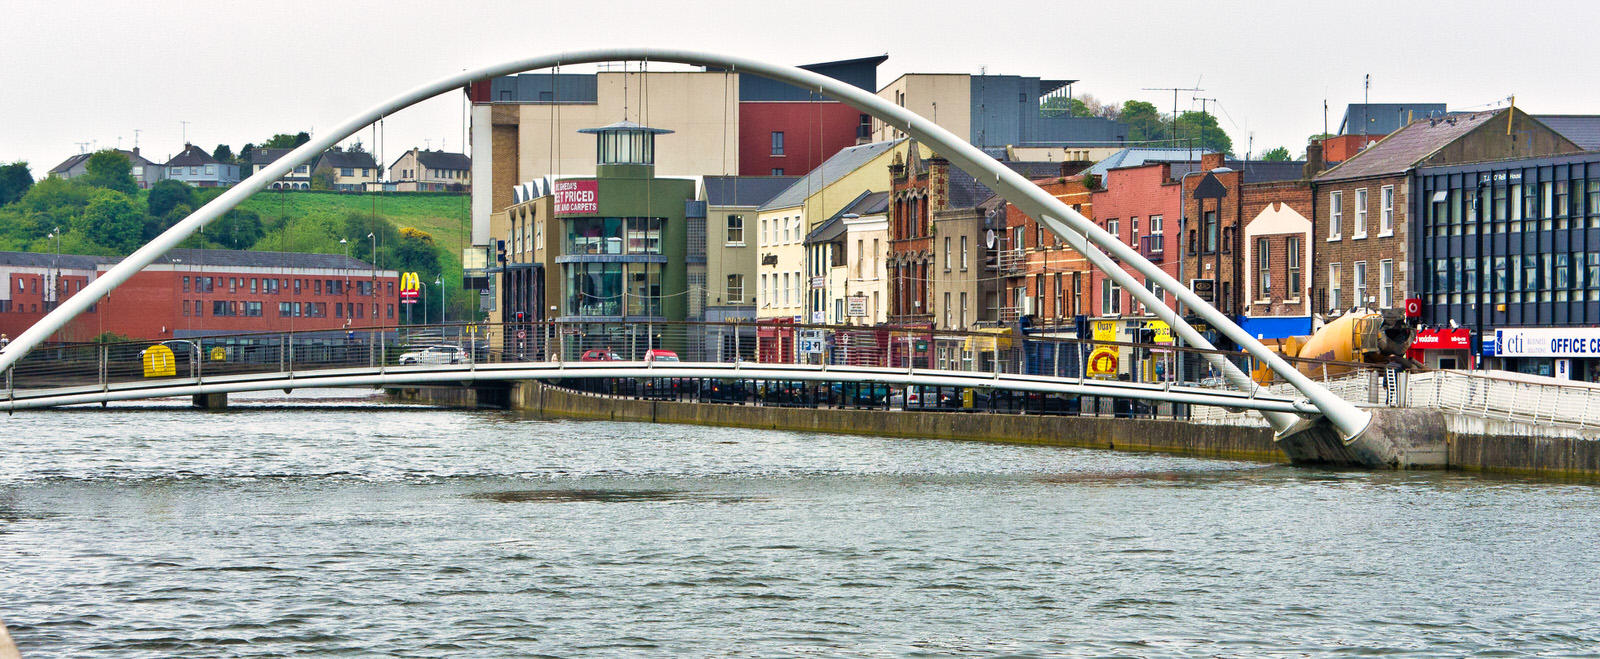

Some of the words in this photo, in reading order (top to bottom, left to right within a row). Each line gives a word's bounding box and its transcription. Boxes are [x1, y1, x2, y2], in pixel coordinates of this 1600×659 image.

[565, 190, 594, 203] PRICED
[570, 203, 597, 211] CARPETS
[1097, 321, 1113, 333] Quay
[1418, 335, 1439, 343] vodafone
[1507, 332, 1524, 354] cti
[1551, 338, 1586, 353] OFFICE
